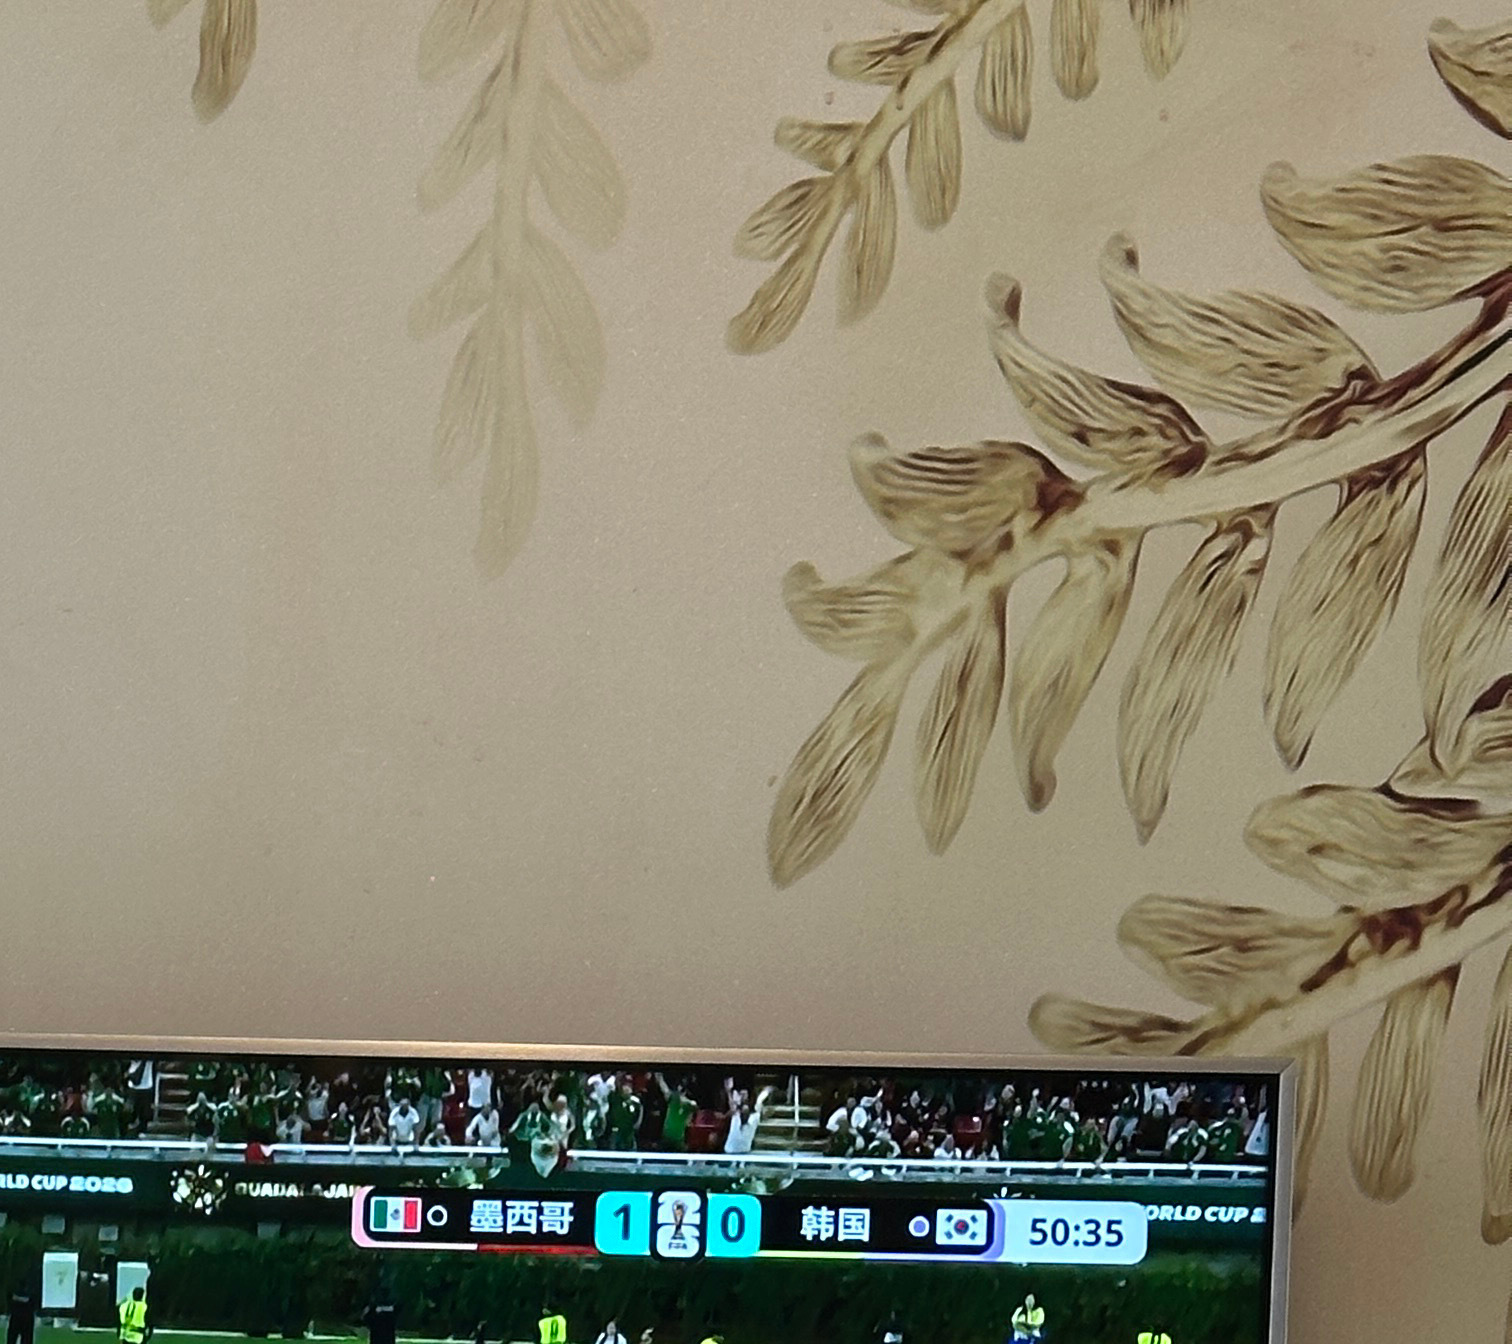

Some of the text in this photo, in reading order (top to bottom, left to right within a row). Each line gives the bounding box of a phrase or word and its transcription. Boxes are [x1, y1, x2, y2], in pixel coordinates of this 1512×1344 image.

[30, 1173, 68, 1193] CUP
[68, 1175, 134, 1194] 2026
[469, 1199, 1125, 1248] 墨西哥 1 0 韩国 50:35
[1143, 1204, 1202, 1221] ORLD
[1204, 1206, 1249, 1223] CUP
